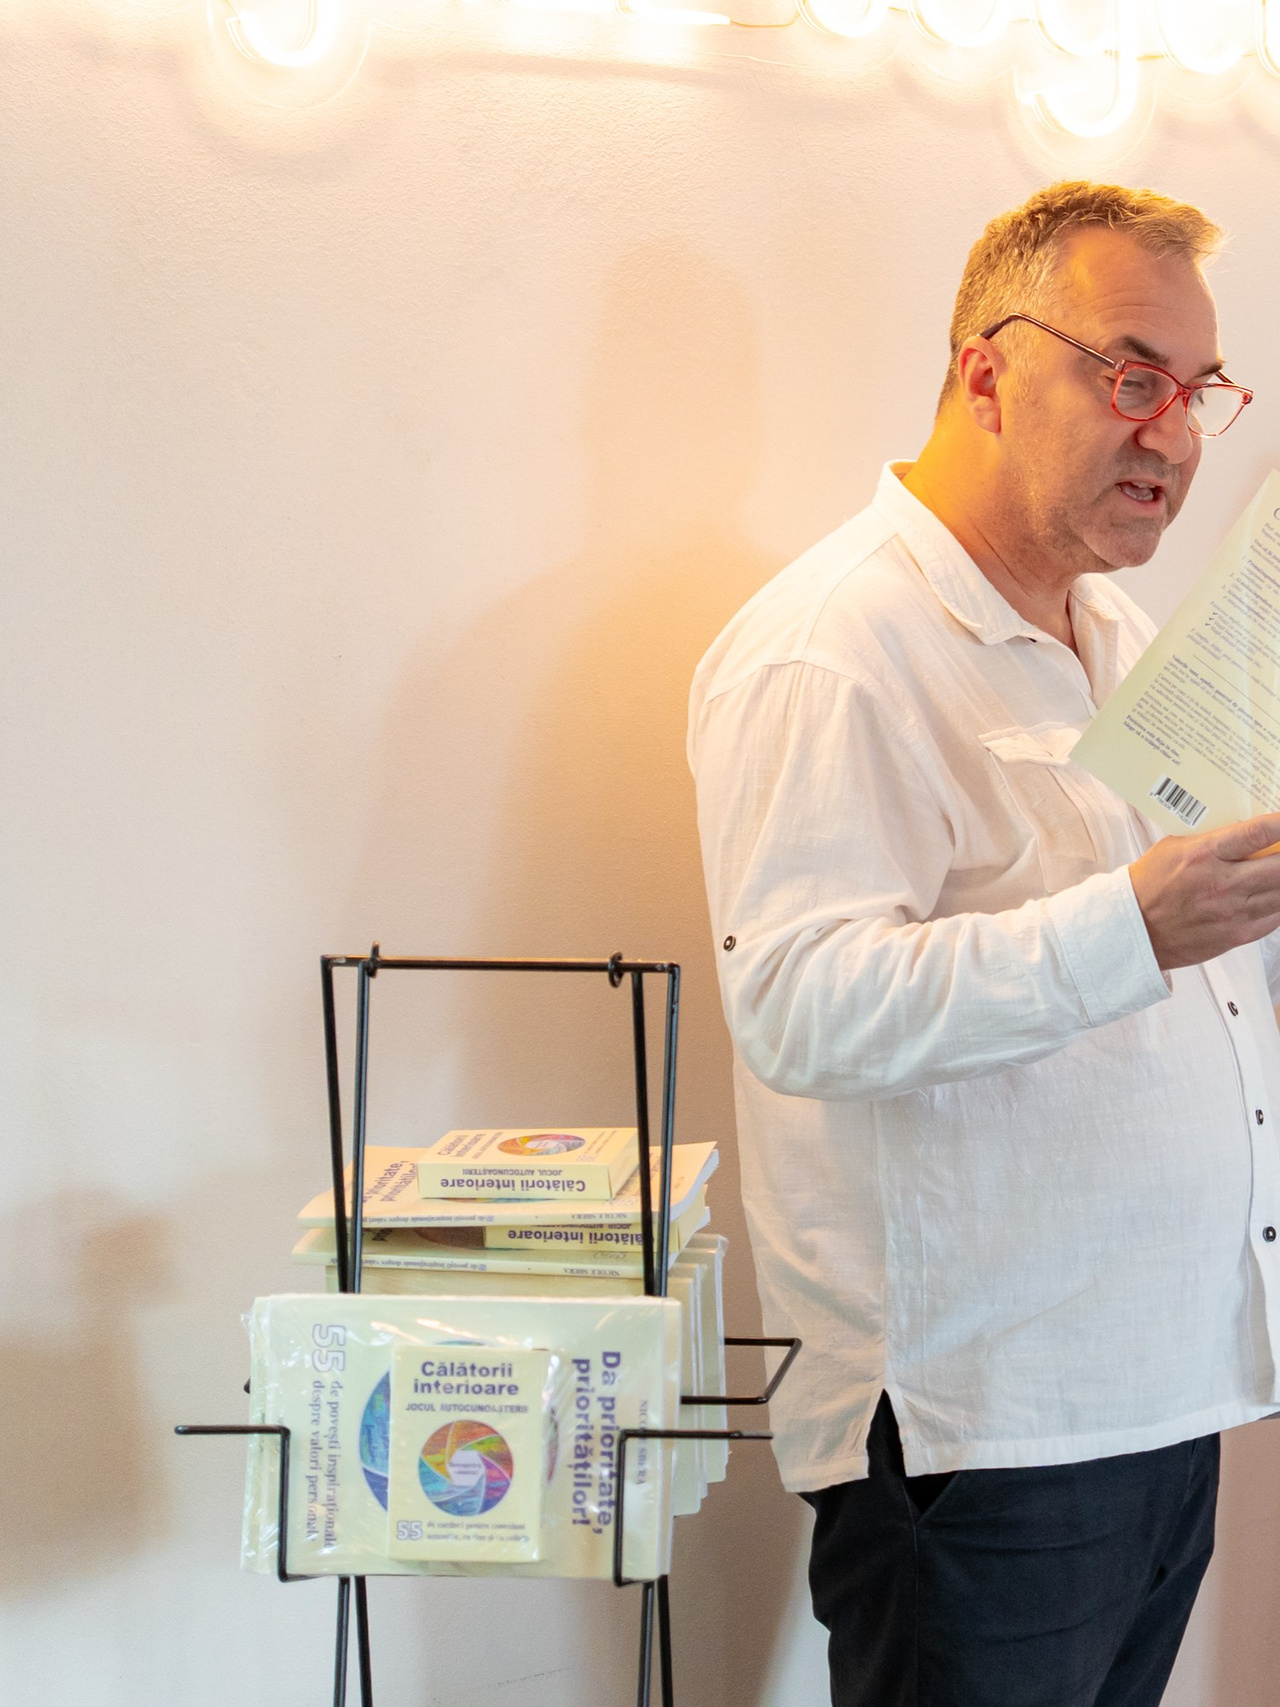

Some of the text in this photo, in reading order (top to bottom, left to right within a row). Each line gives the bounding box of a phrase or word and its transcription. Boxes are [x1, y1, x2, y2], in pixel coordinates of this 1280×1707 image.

[440, 1178, 586, 1192] Călătorii interioare
[508, 1230, 644, 1246] ălătorii interioare
[311, 1323, 347, 1373] 55
[421, 1361, 513, 1377] Călătorii
[330, 1380, 344, 1397] de
[413, 1379, 519, 1396] interioare
[310, 1380, 326, 1426] despre
[406, 1403, 436, 1412] JOCUL
[326, 1401, 342, 1449] povești
[310, 1431, 323, 1471] valori
[567, 1358, 594, 1526] priorităților!
[592, 1396, 620, 1534] prioritate,
[396, 1520, 423, 1541] 55
